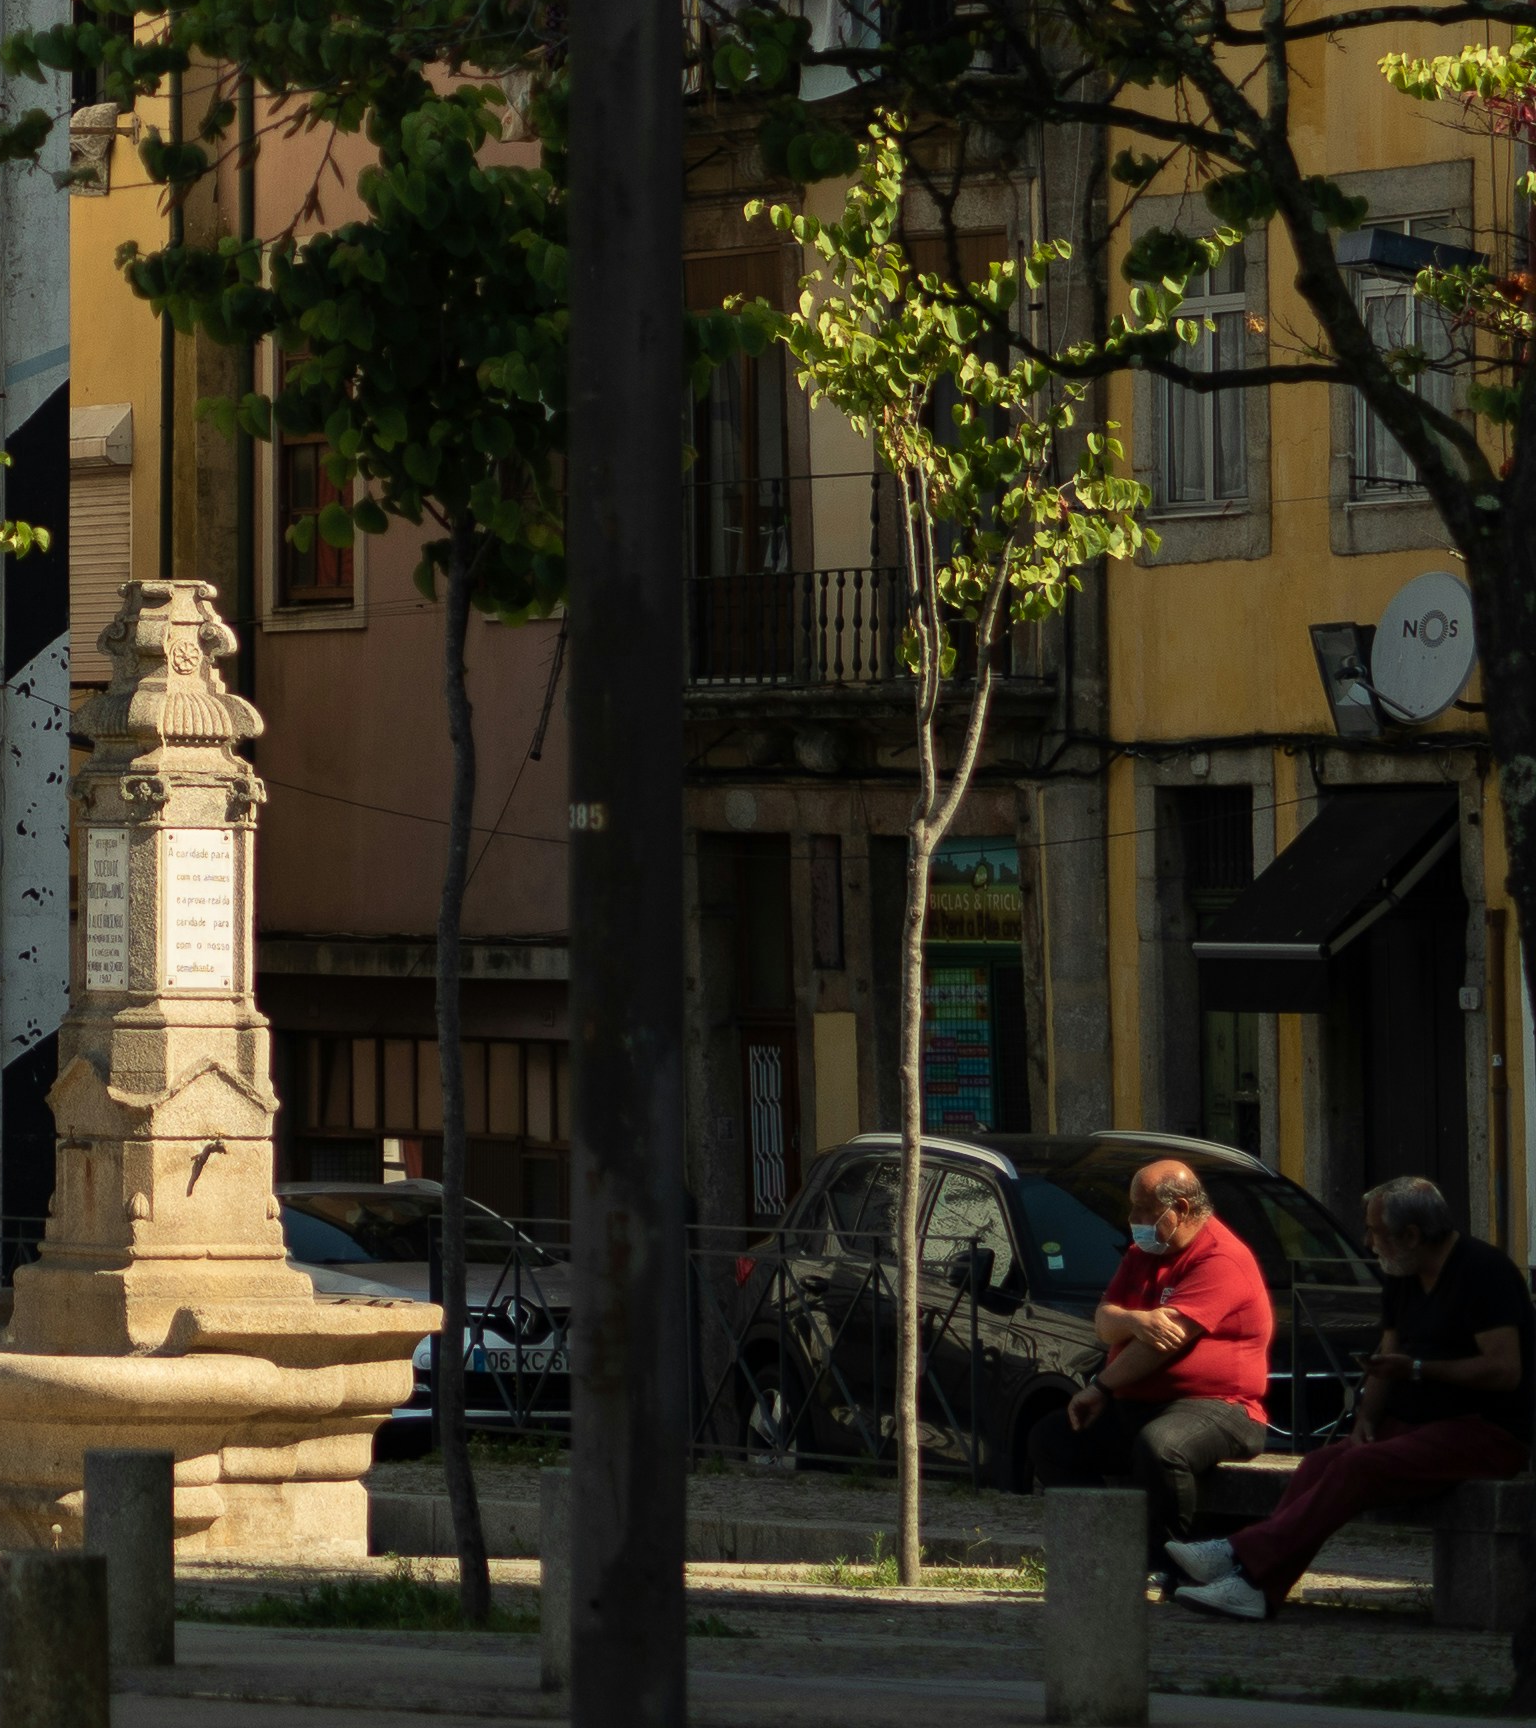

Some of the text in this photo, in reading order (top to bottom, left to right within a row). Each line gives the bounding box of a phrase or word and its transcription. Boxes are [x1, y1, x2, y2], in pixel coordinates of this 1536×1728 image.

[1403, 609, 1458, 648] NOS
[176, 848, 208, 859] caridade
[211, 851, 230, 861] para
[192, 874, 201, 882] os
[930, 893, 969, 911] BICLAS
[974, 894, 982, 911] &
[176, 916, 230, 931] caridade para
[176, 942, 230, 951] com o nosso
